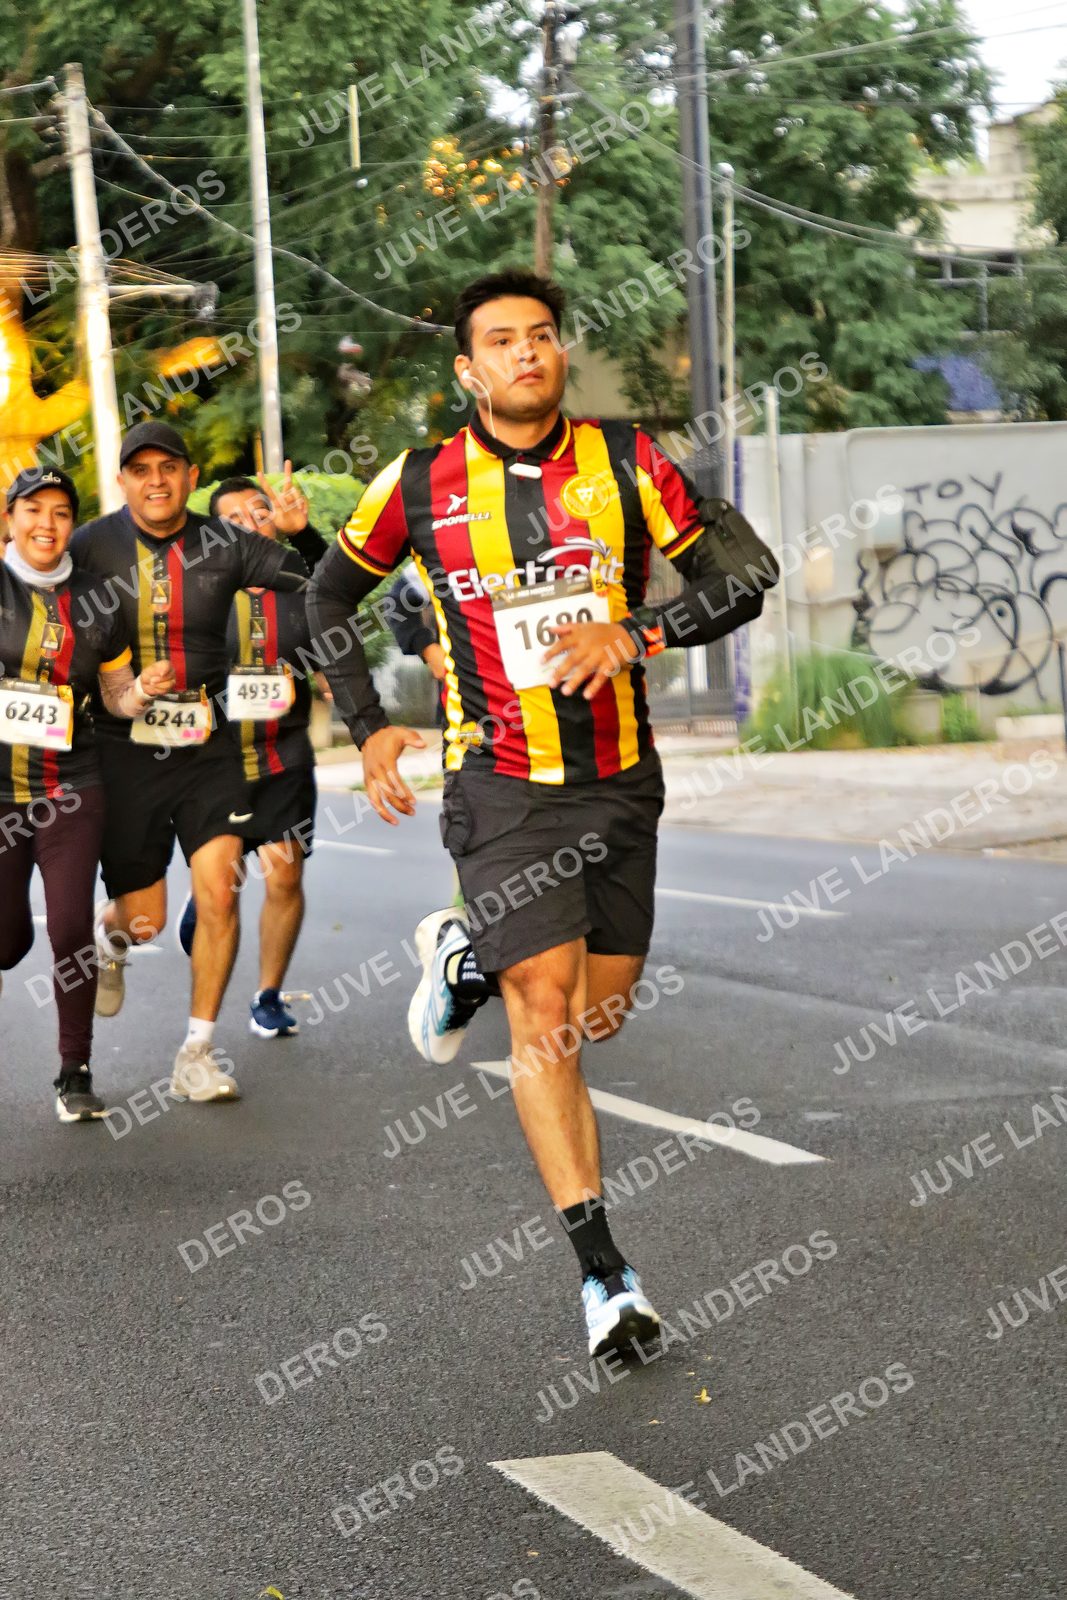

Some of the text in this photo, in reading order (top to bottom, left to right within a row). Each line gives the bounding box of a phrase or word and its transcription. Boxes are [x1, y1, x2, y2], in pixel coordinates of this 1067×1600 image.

[41, 472, 61, 484] alo
[904, 471, 1003, 510] TOY
[432, 511, 491, 530] SPORELLI
[237, 682, 281, 700] 4935
[5, 700, 58, 725] 6243
[144, 708, 196, 728] 6244
